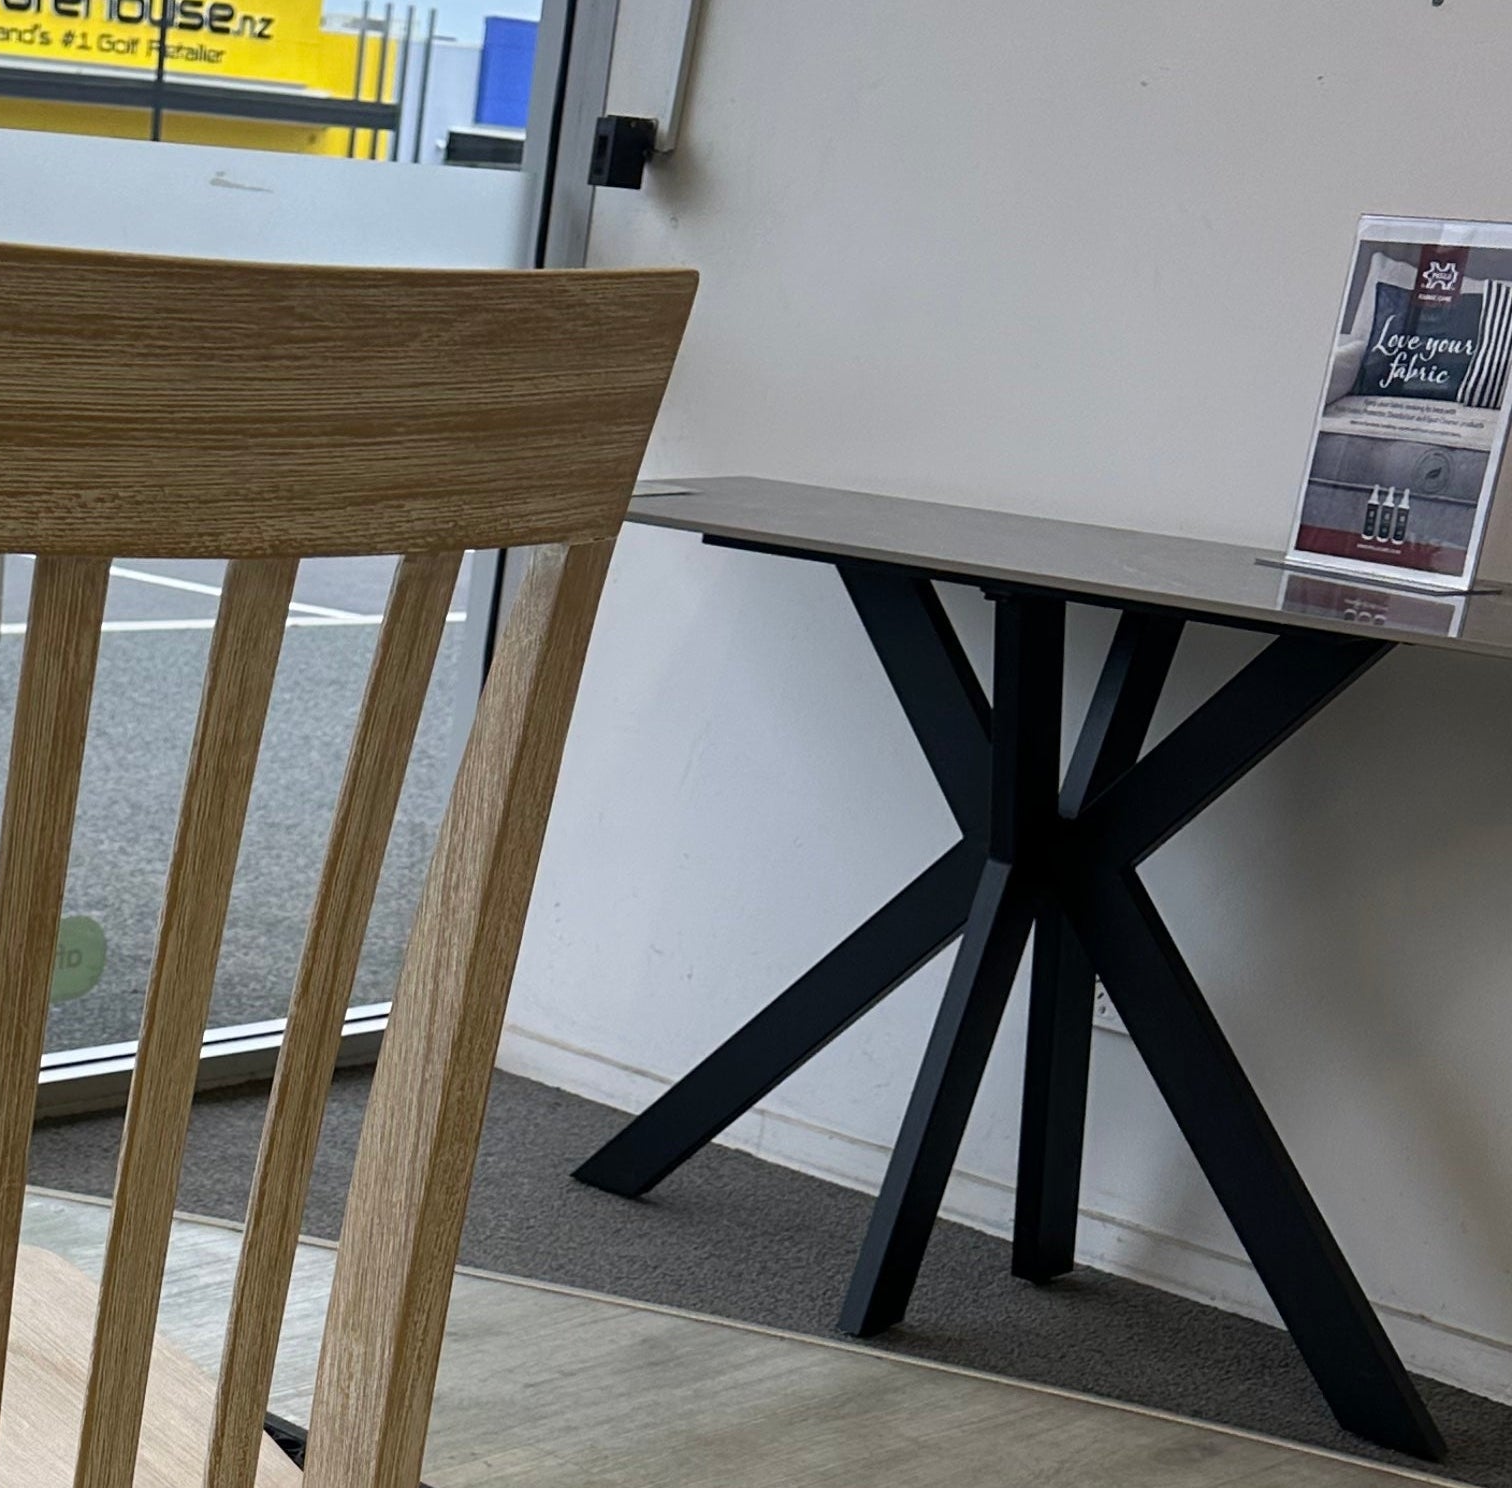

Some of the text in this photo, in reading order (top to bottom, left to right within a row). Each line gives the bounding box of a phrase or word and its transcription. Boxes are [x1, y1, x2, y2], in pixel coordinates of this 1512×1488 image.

[62, 29, 92, 51] #1
[96, 33, 141, 55] Golf
[1372, 314, 1476, 362] Love your
[1379, 351, 1450, 388] fabric
